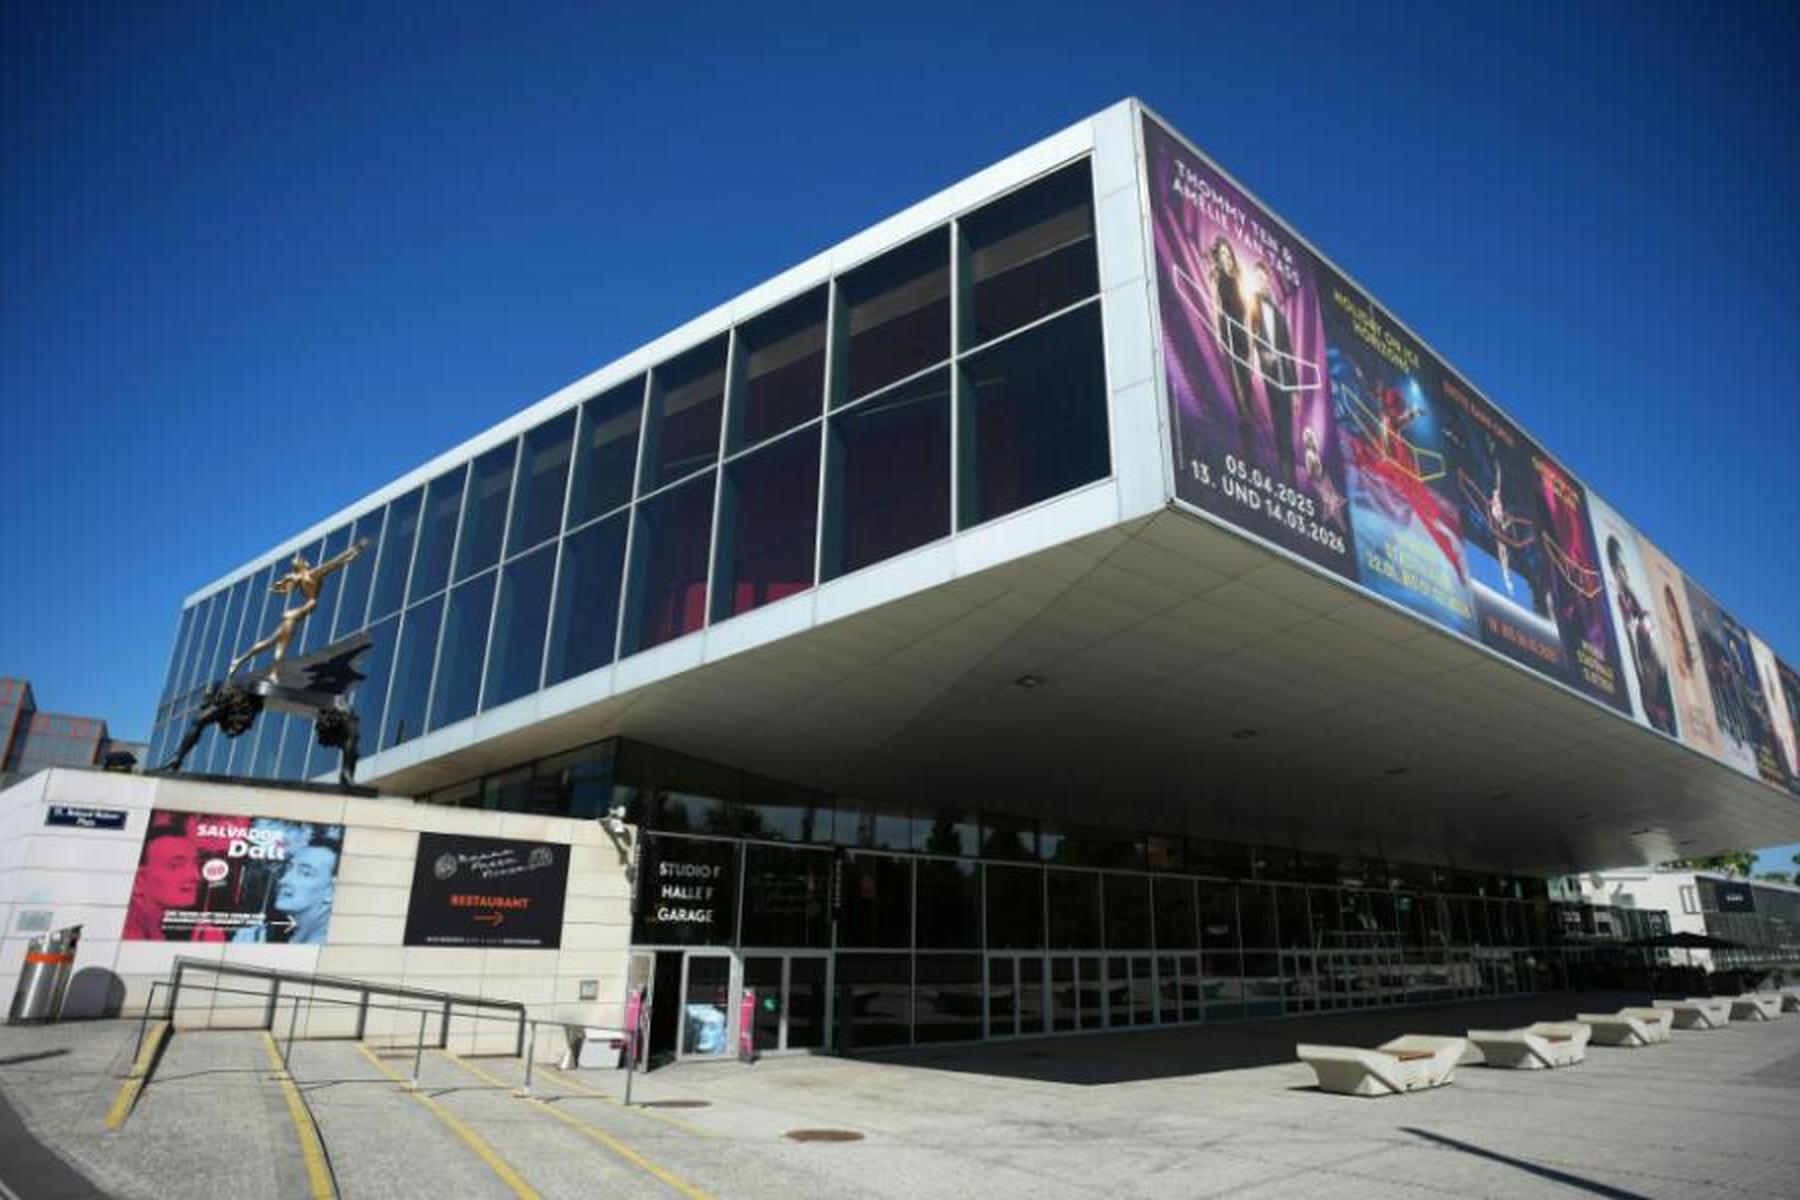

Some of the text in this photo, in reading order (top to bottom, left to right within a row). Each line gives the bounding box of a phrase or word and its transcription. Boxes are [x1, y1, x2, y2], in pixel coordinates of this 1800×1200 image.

[1174, 160, 1245, 225] THOMMY
[1225, 454, 1315, 516] 05.04.2025
[1191, 459, 1346, 555] 13. UND 14.03.2026
[196, 823, 283, 841] SALVADOR
[659, 861, 711, 878] STUDIO
[661, 883, 702, 900] HALLE
[450, 894, 531, 909] RESTAURANT
[657, 907, 714, 923] GARAGE
